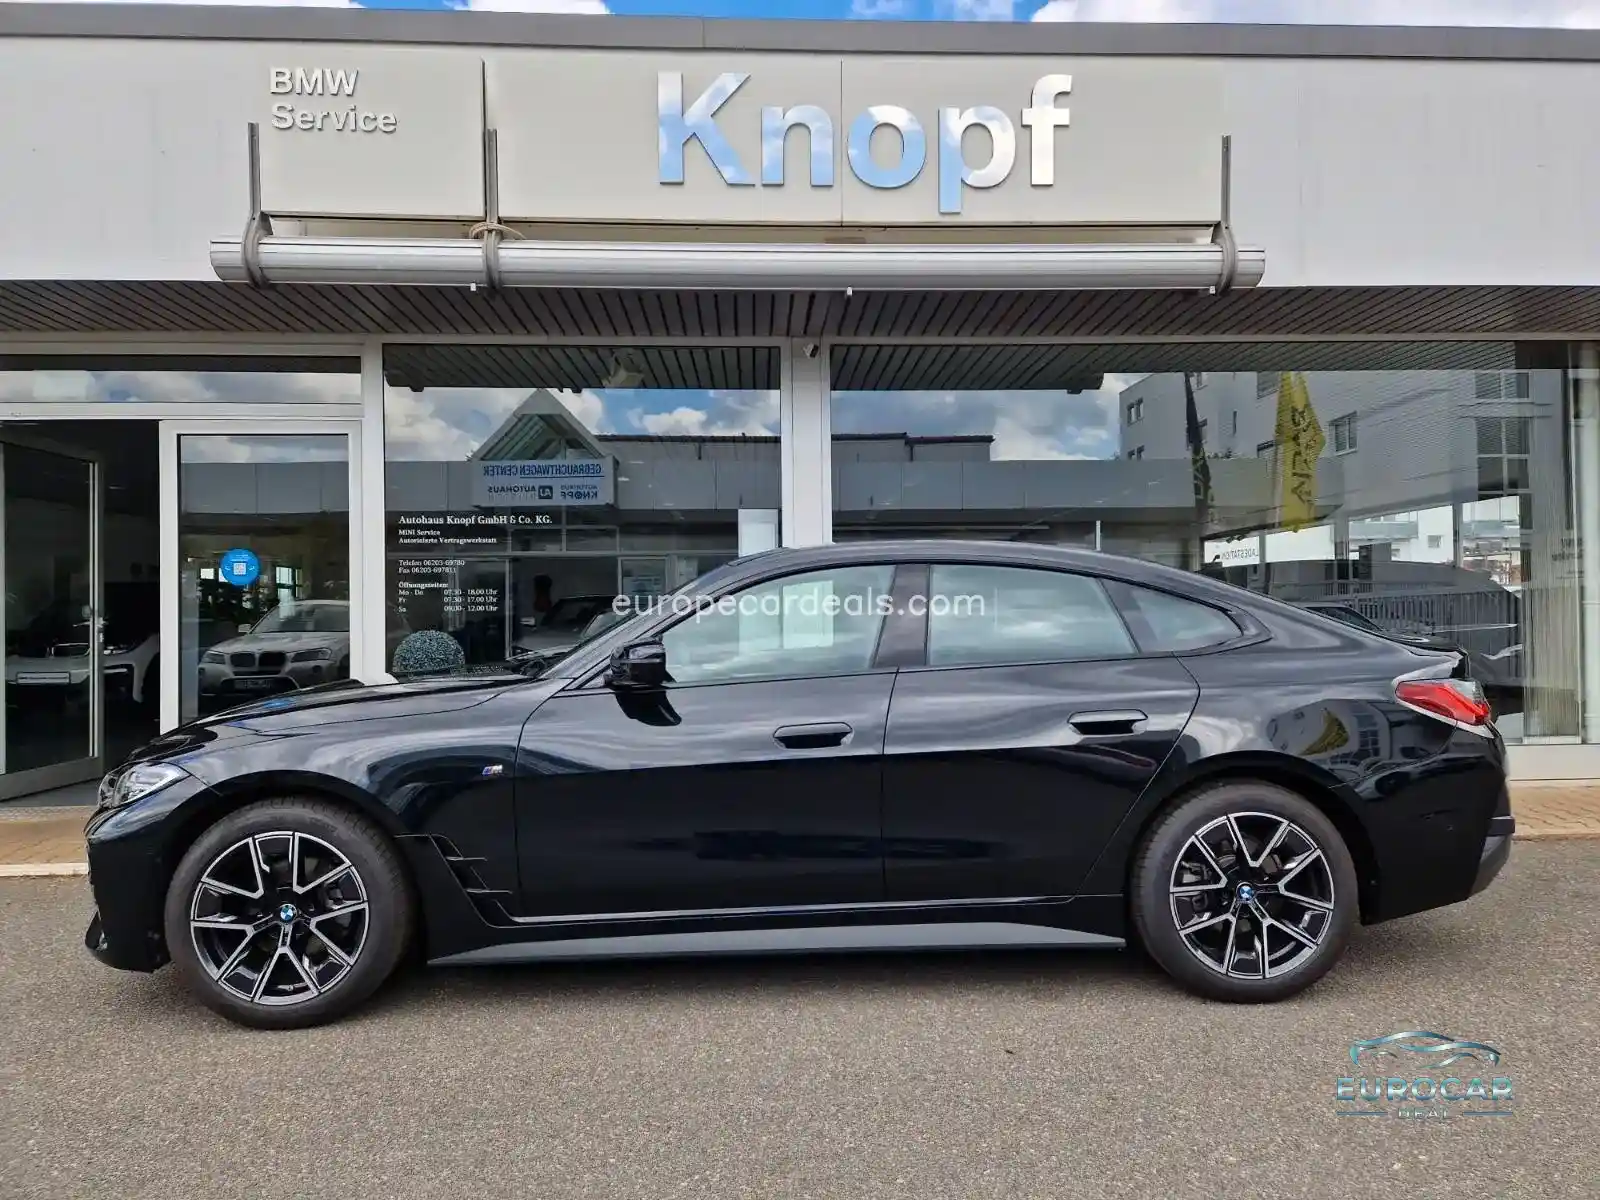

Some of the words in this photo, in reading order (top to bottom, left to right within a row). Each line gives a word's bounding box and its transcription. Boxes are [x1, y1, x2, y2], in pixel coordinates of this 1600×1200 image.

[270, 67, 359, 97] BMW
[271, 103, 398, 133] Service
[658, 72, 1073, 214] Knopf
[398, 515, 444, 525] Autohaus
[446, 515, 476, 526] Knopf
[477, 515, 507, 525] GmbH
[509, 515, 516, 525] &
[518, 515, 533, 525] Co.
[535, 515, 553, 525] KG.
